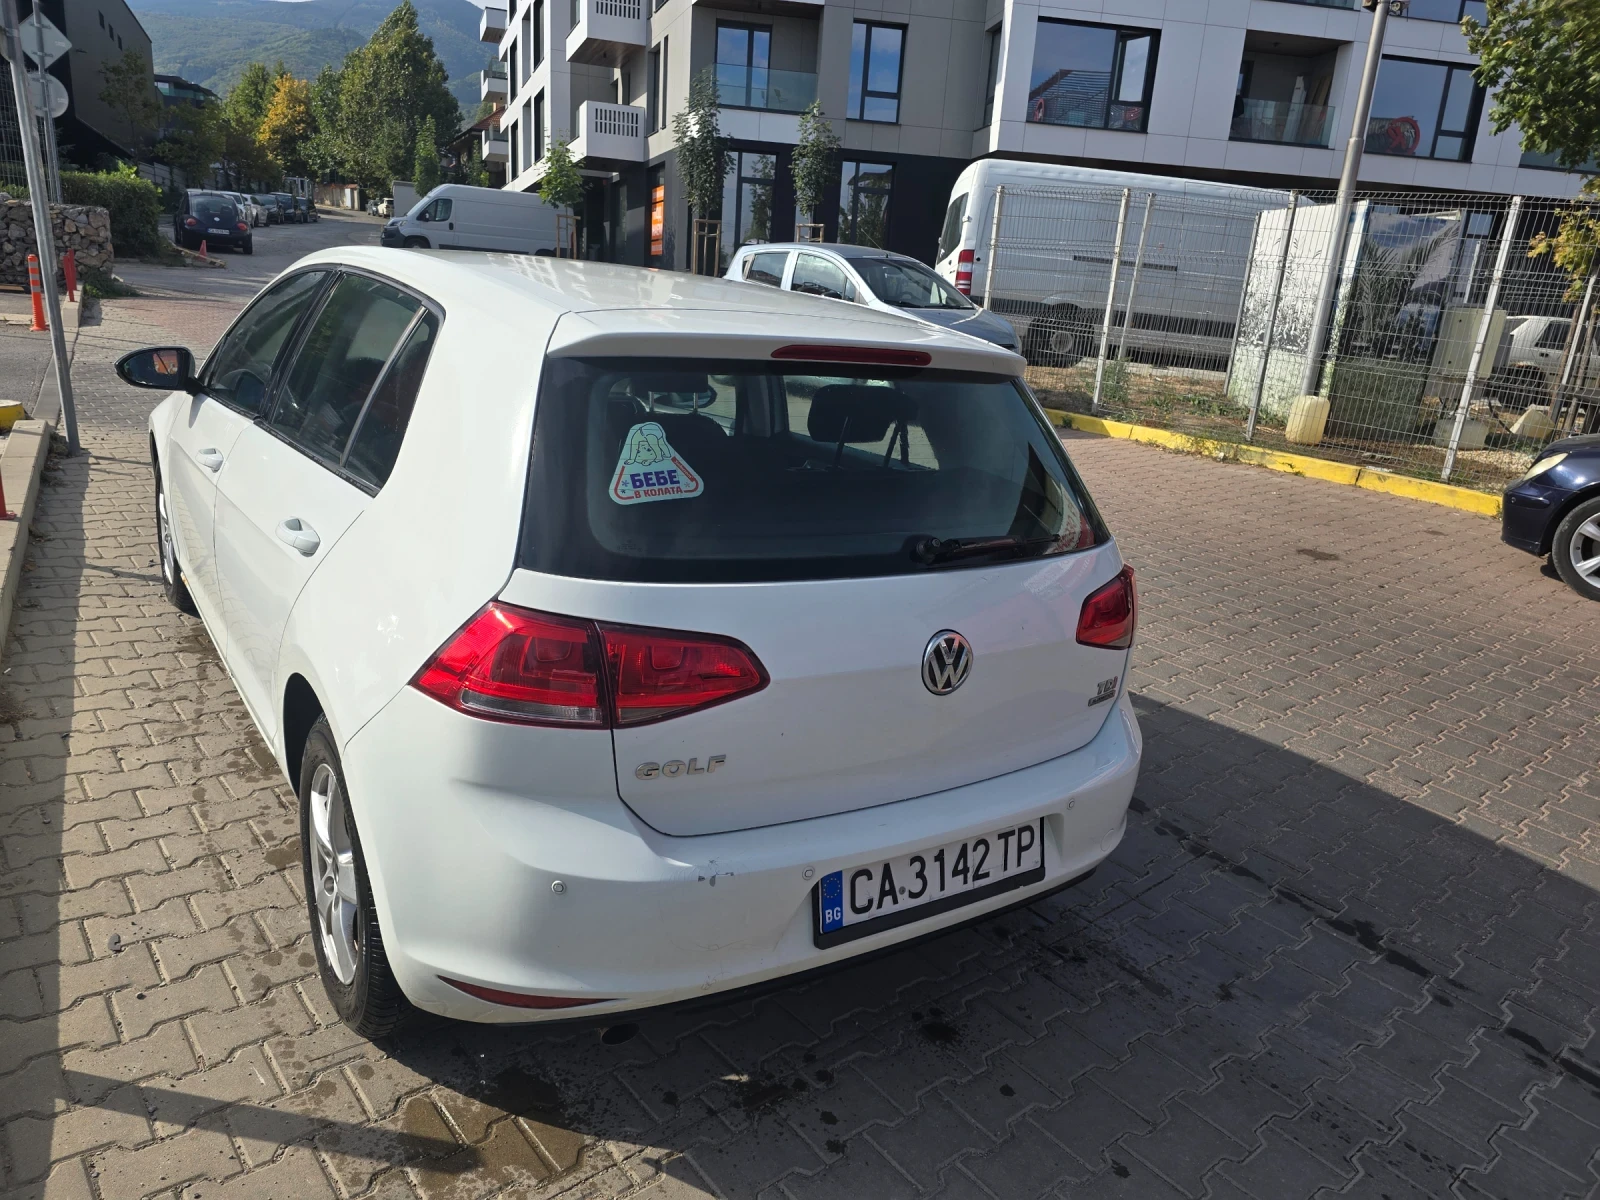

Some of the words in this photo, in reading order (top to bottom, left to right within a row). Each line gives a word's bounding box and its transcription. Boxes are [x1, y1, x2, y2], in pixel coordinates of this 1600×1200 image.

[629, 469, 680, 489] БЕБЕ
[633, 490, 642, 499] В
[643, 486, 684, 497] КОЛАТА
[926, 632, 971, 693] VW
[1097, 675, 1118, 696] TDI
[635, 754, 726, 780] GOLF
[825, 906, 842, 924] BG
